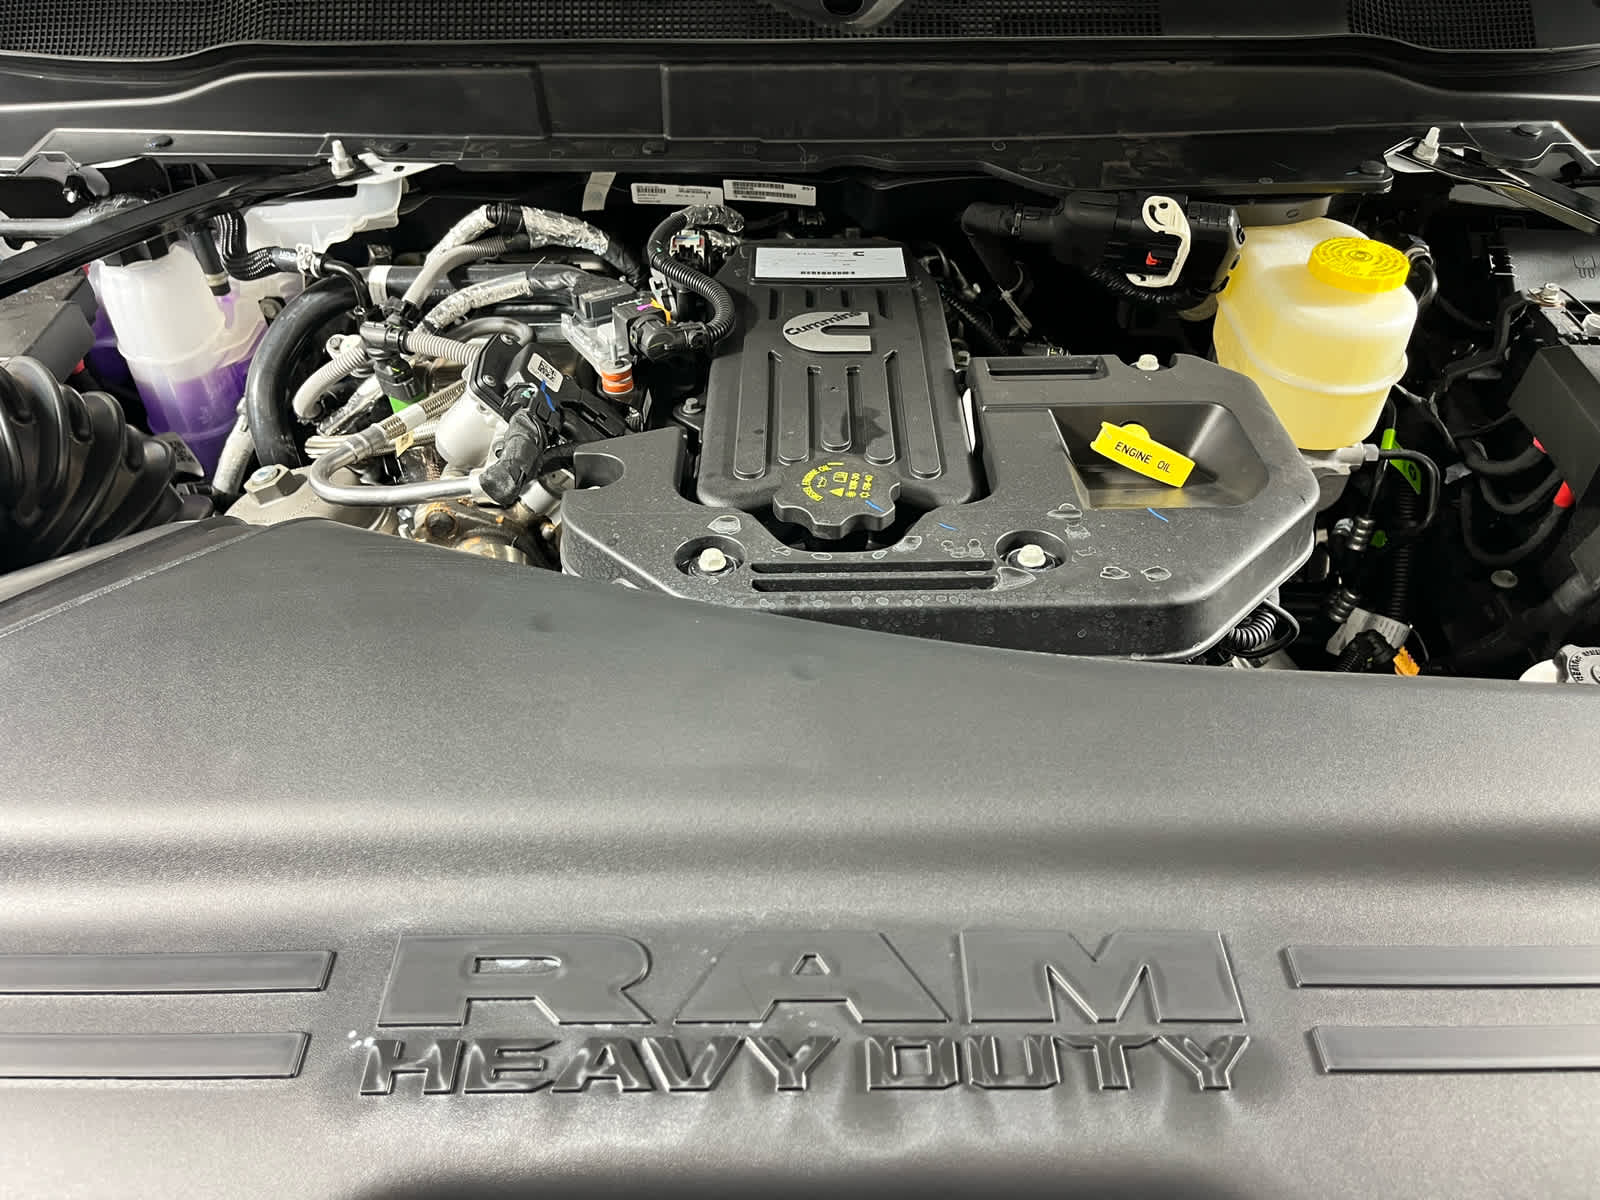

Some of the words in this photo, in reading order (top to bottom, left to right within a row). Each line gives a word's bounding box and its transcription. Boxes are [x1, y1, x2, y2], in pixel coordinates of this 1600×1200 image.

[784, 311, 862, 335] Cummins
[1115, 442, 1152, 464] ENGINE
[1156, 460, 1172, 474] OIL
[377, 930, 1246, 1026] RAM
[360, 1034, 841, 1096] HEAVY
[865, 1034, 1252, 1093] DUTY
